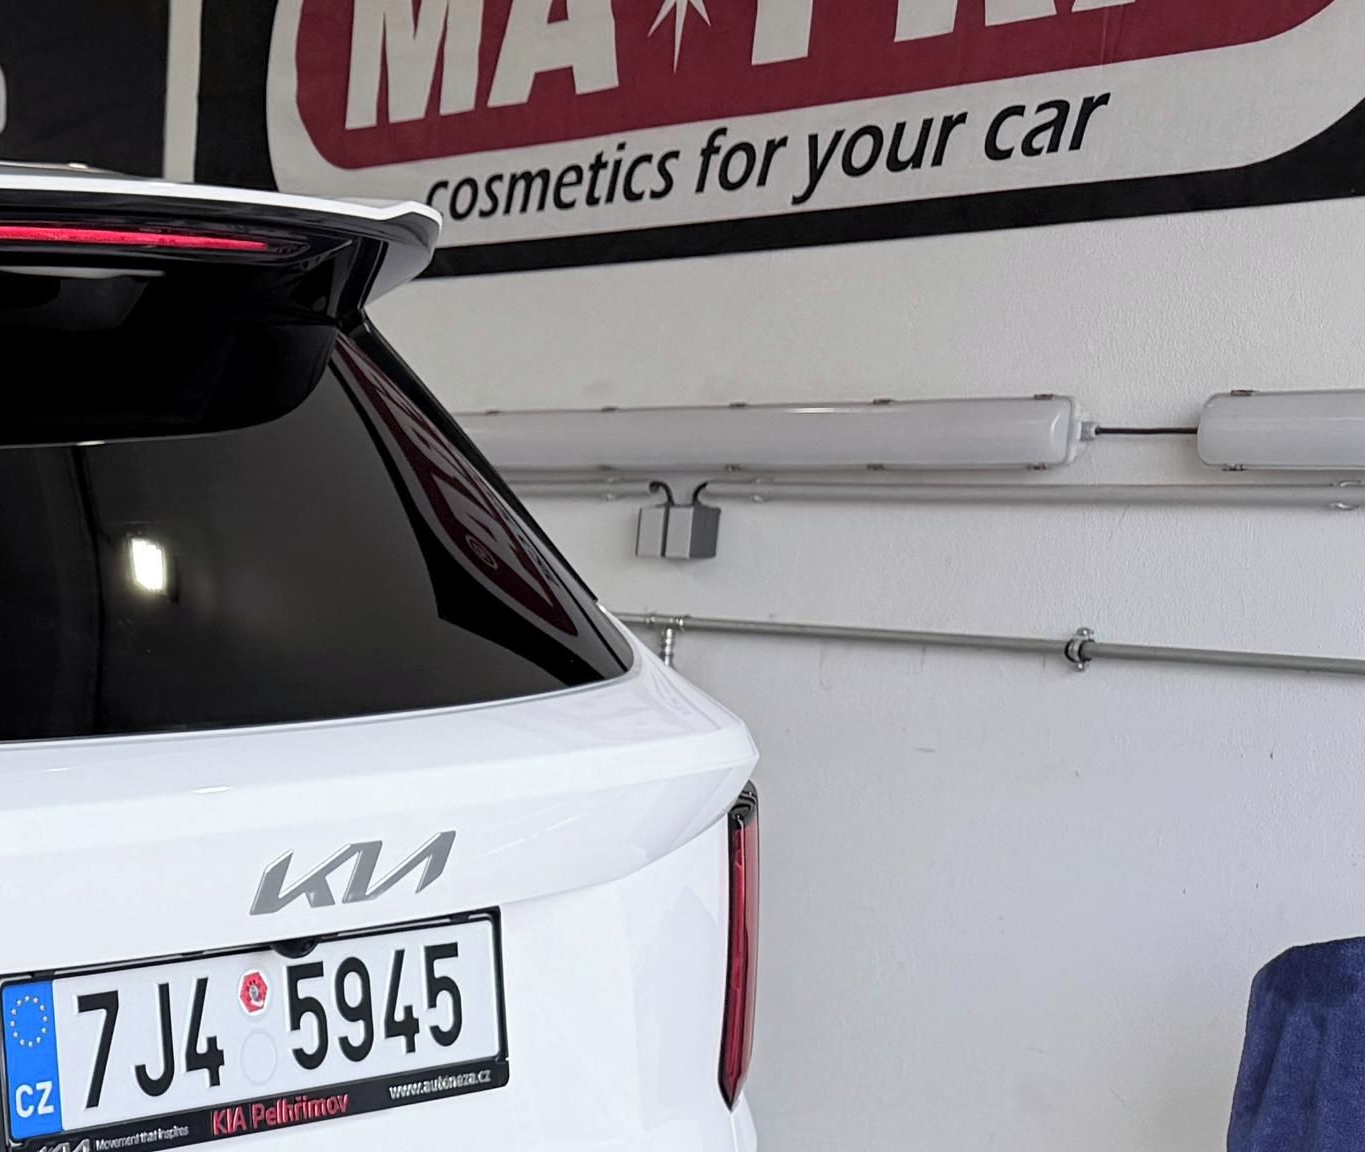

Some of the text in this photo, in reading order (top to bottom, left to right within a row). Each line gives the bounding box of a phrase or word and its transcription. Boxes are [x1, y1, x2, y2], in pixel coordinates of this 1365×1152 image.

[425, 92, 1111, 221] cosmetics for your car
[249, 830, 457, 916] KIA
[77, 941, 463, 1110] 7J4 5945
[15, 1080, 54, 1119] CZ
[213, 1093, 349, 1136] KIA Pelhřimov
[95, 1133, 140, 1152] Movement
